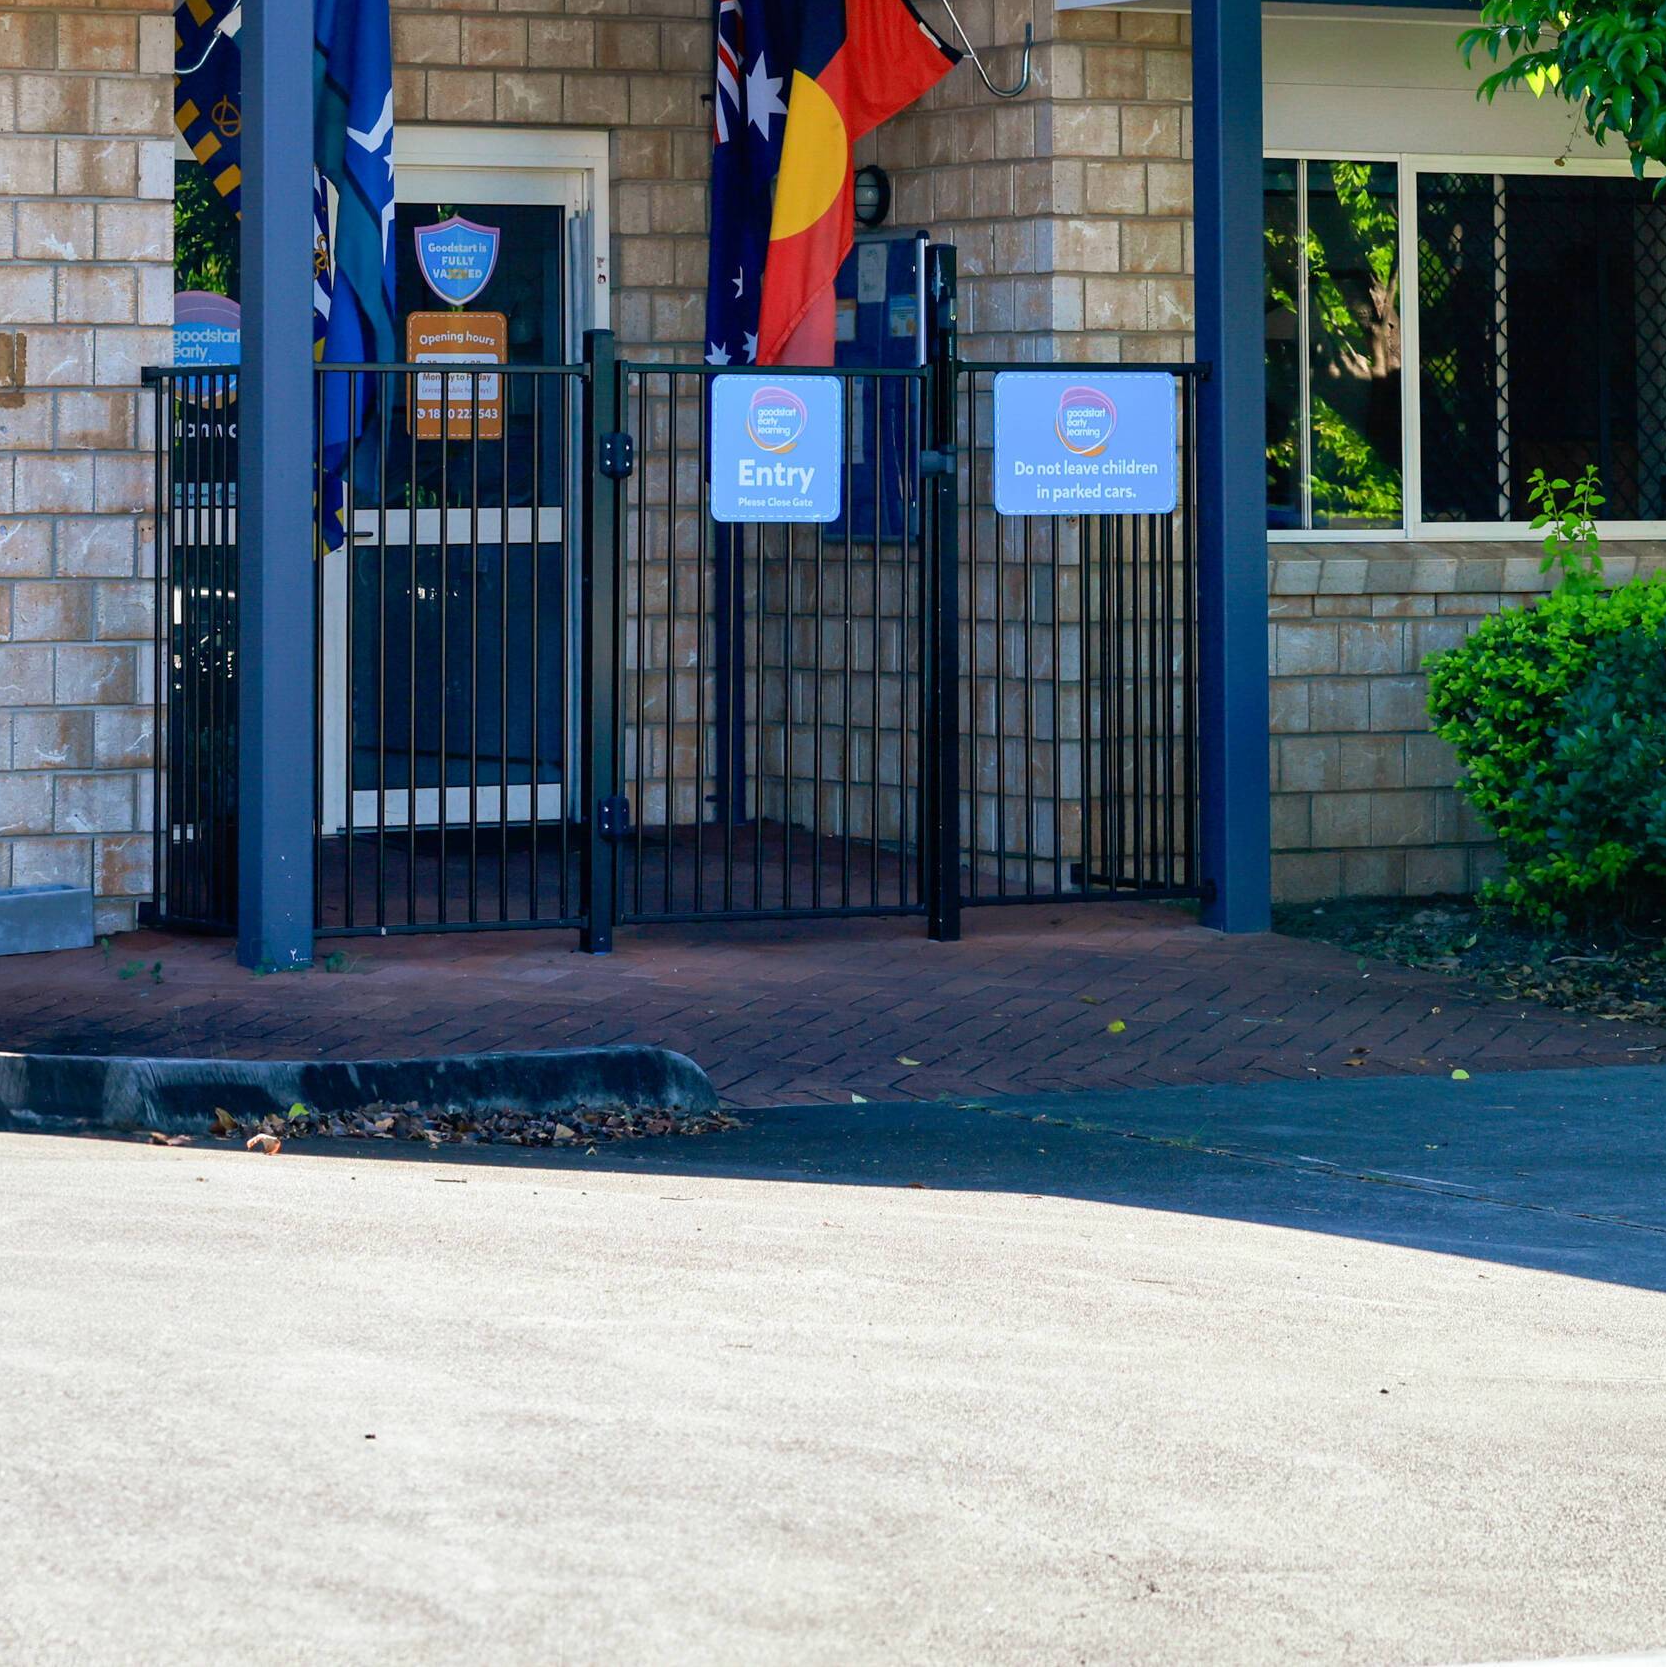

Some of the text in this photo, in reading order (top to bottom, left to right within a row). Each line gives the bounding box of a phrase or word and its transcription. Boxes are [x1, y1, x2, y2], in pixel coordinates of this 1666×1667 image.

[428, 242, 487, 253] Goodstart is
[441, 256, 475, 266] FULLY
[419, 330, 495, 346] Opening hours
[173, 346, 208, 362] early
[422, 373, 492, 383] Mony to Fday
[429, 408, 455, 419] 180
[478, 408, 498, 419] 543
[757, 407, 796, 419] goodstart
[1067, 408, 1105, 419] goodstart
[757, 417, 778, 427] early
[1067, 417, 1087, 427] early
[757, 426, 790, 436] learning
[1067, 427, 1100, 438] learning
[1014, 460, 1158, 476] Do not leave children
[738, 459, 815, 494] Entry
[1036, 483, 1137, 502] in parked cars.
[738, 497, 813, 507] Please Close Gate
